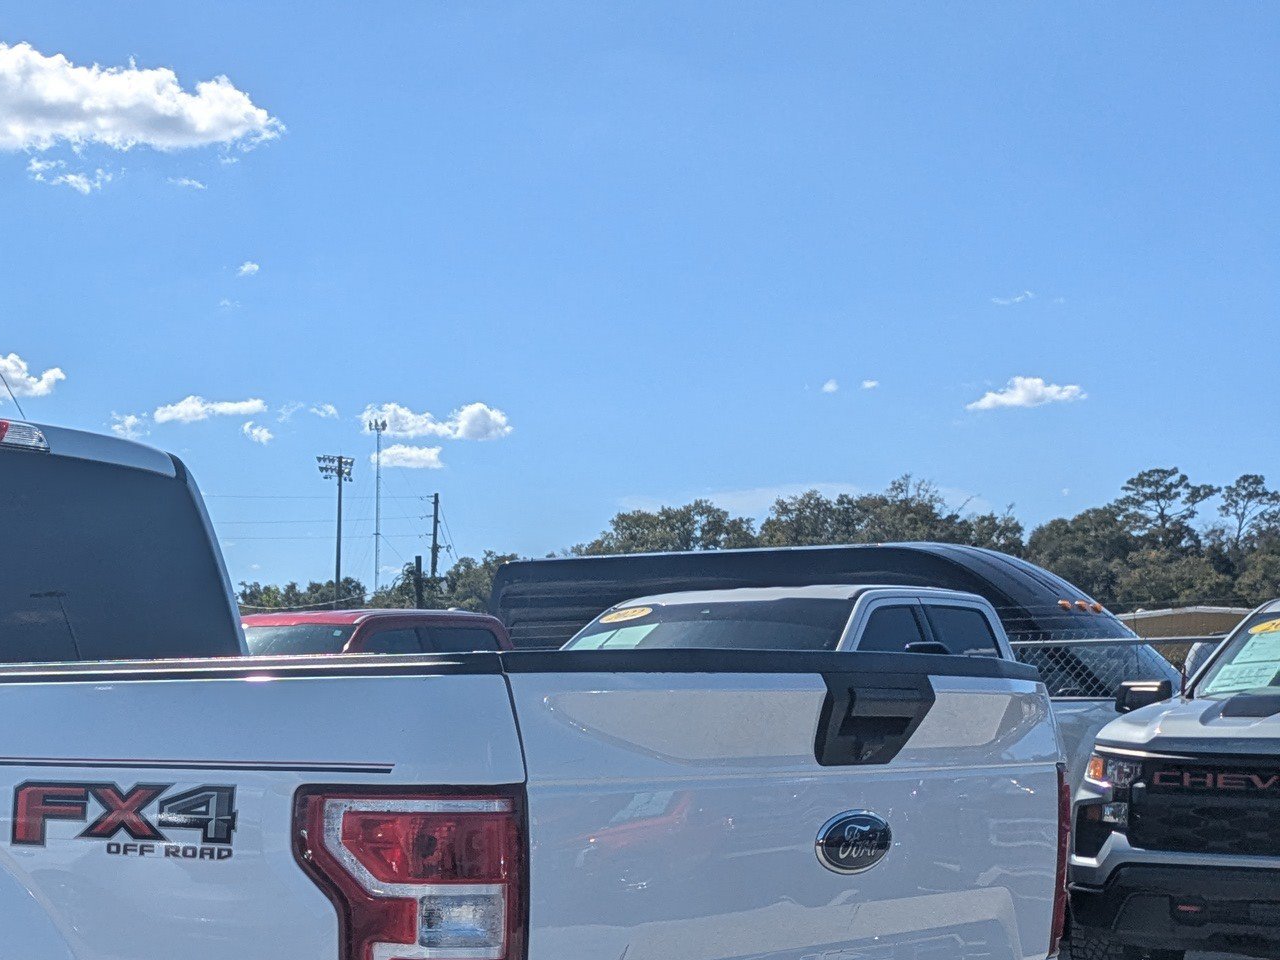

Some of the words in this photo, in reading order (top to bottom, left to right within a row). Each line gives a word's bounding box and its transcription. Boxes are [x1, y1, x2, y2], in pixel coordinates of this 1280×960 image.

[11, 779, 238, 848] FX4
[106, 842, 156, 857] OFF
[164, 844, 234, 860] ROAD
[838, 823, 881, 860] Ford
